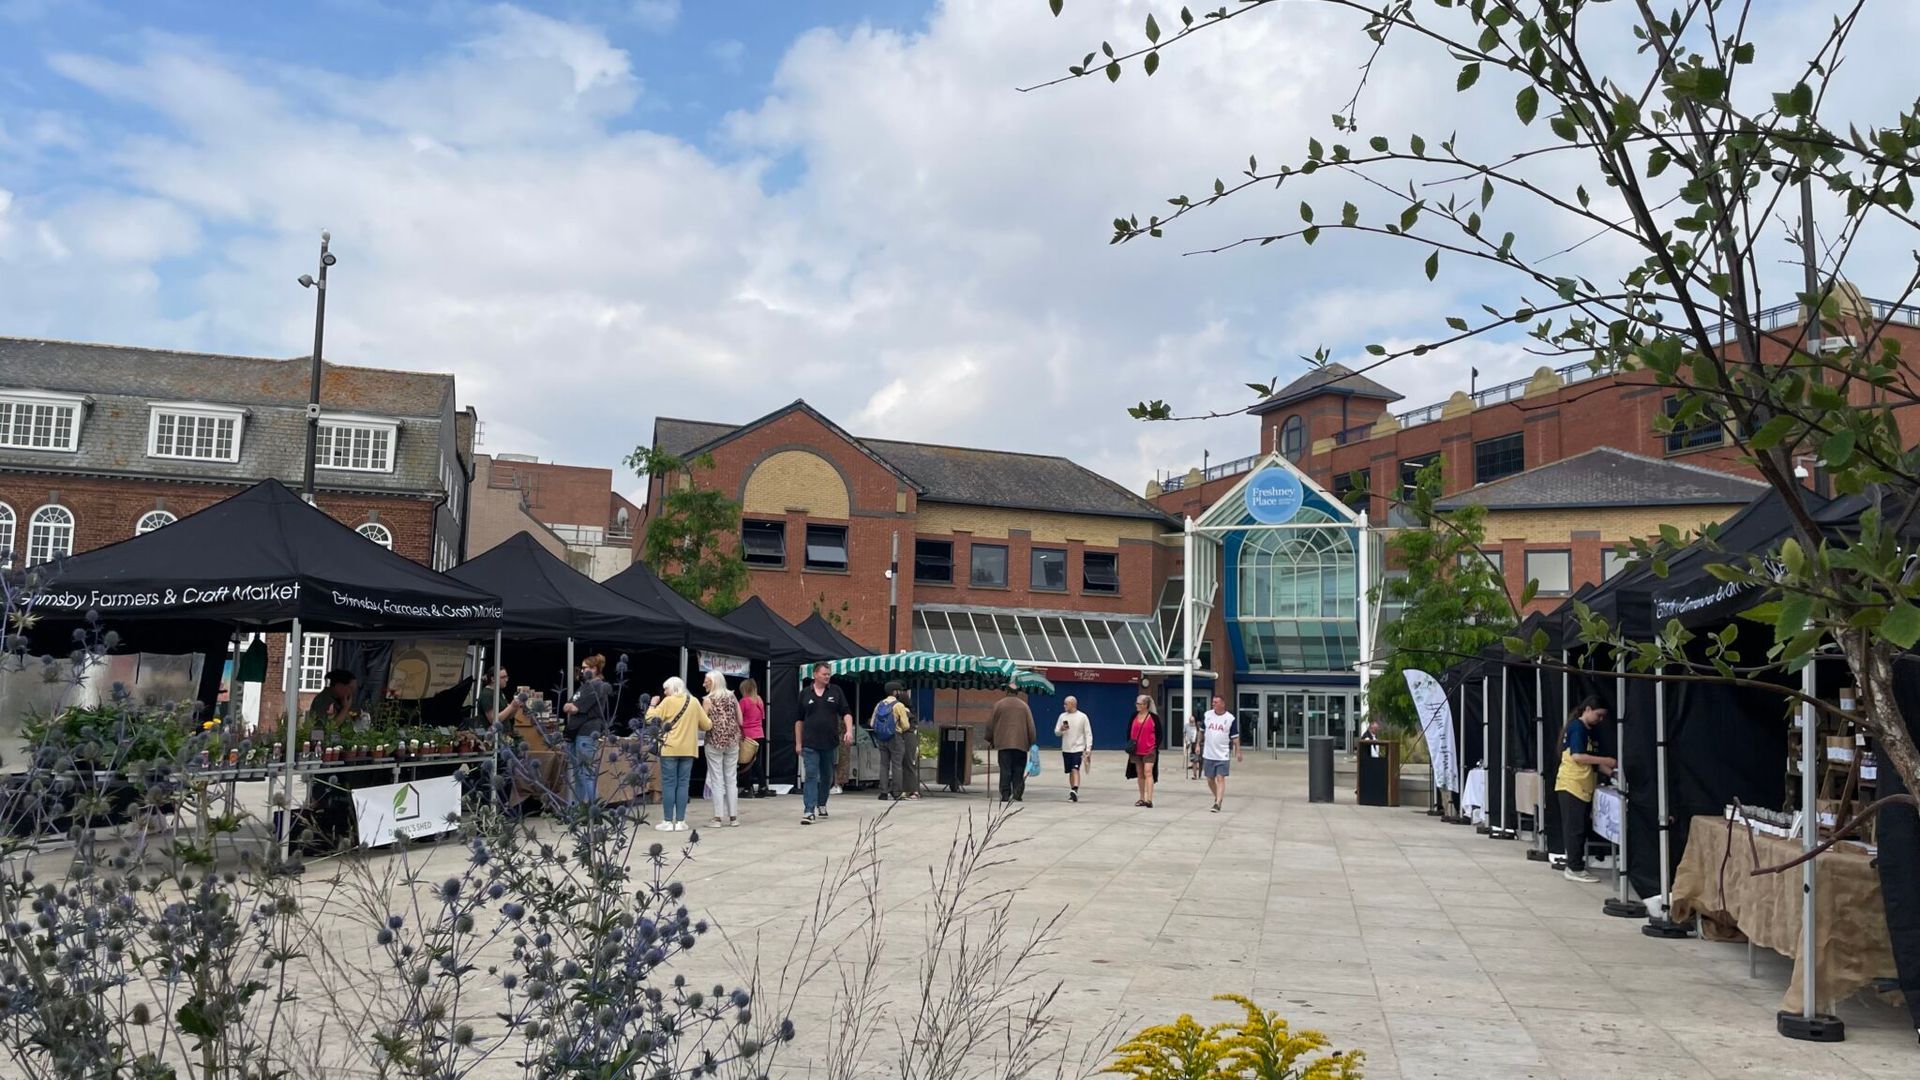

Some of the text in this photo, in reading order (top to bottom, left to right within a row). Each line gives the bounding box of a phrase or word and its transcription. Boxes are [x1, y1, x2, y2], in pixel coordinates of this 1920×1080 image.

[1252, 486, 1295, 497] Freshney
[1252, 497, 1277, 506] Place
[90, 590, 160, 607] Farmers
[163, 588, 178, 605] &
[182, 586, 230, 604] Craft
[232, 581, 301, 602] Market
[383, 599, 432, 617] Farmers
[431, 603, 445, 617] &
[442, 604, 473, 618] Craft
[1208, 723, 1224, 731] AIA
[388, 821, 432, 837] DRYL'S SHED
